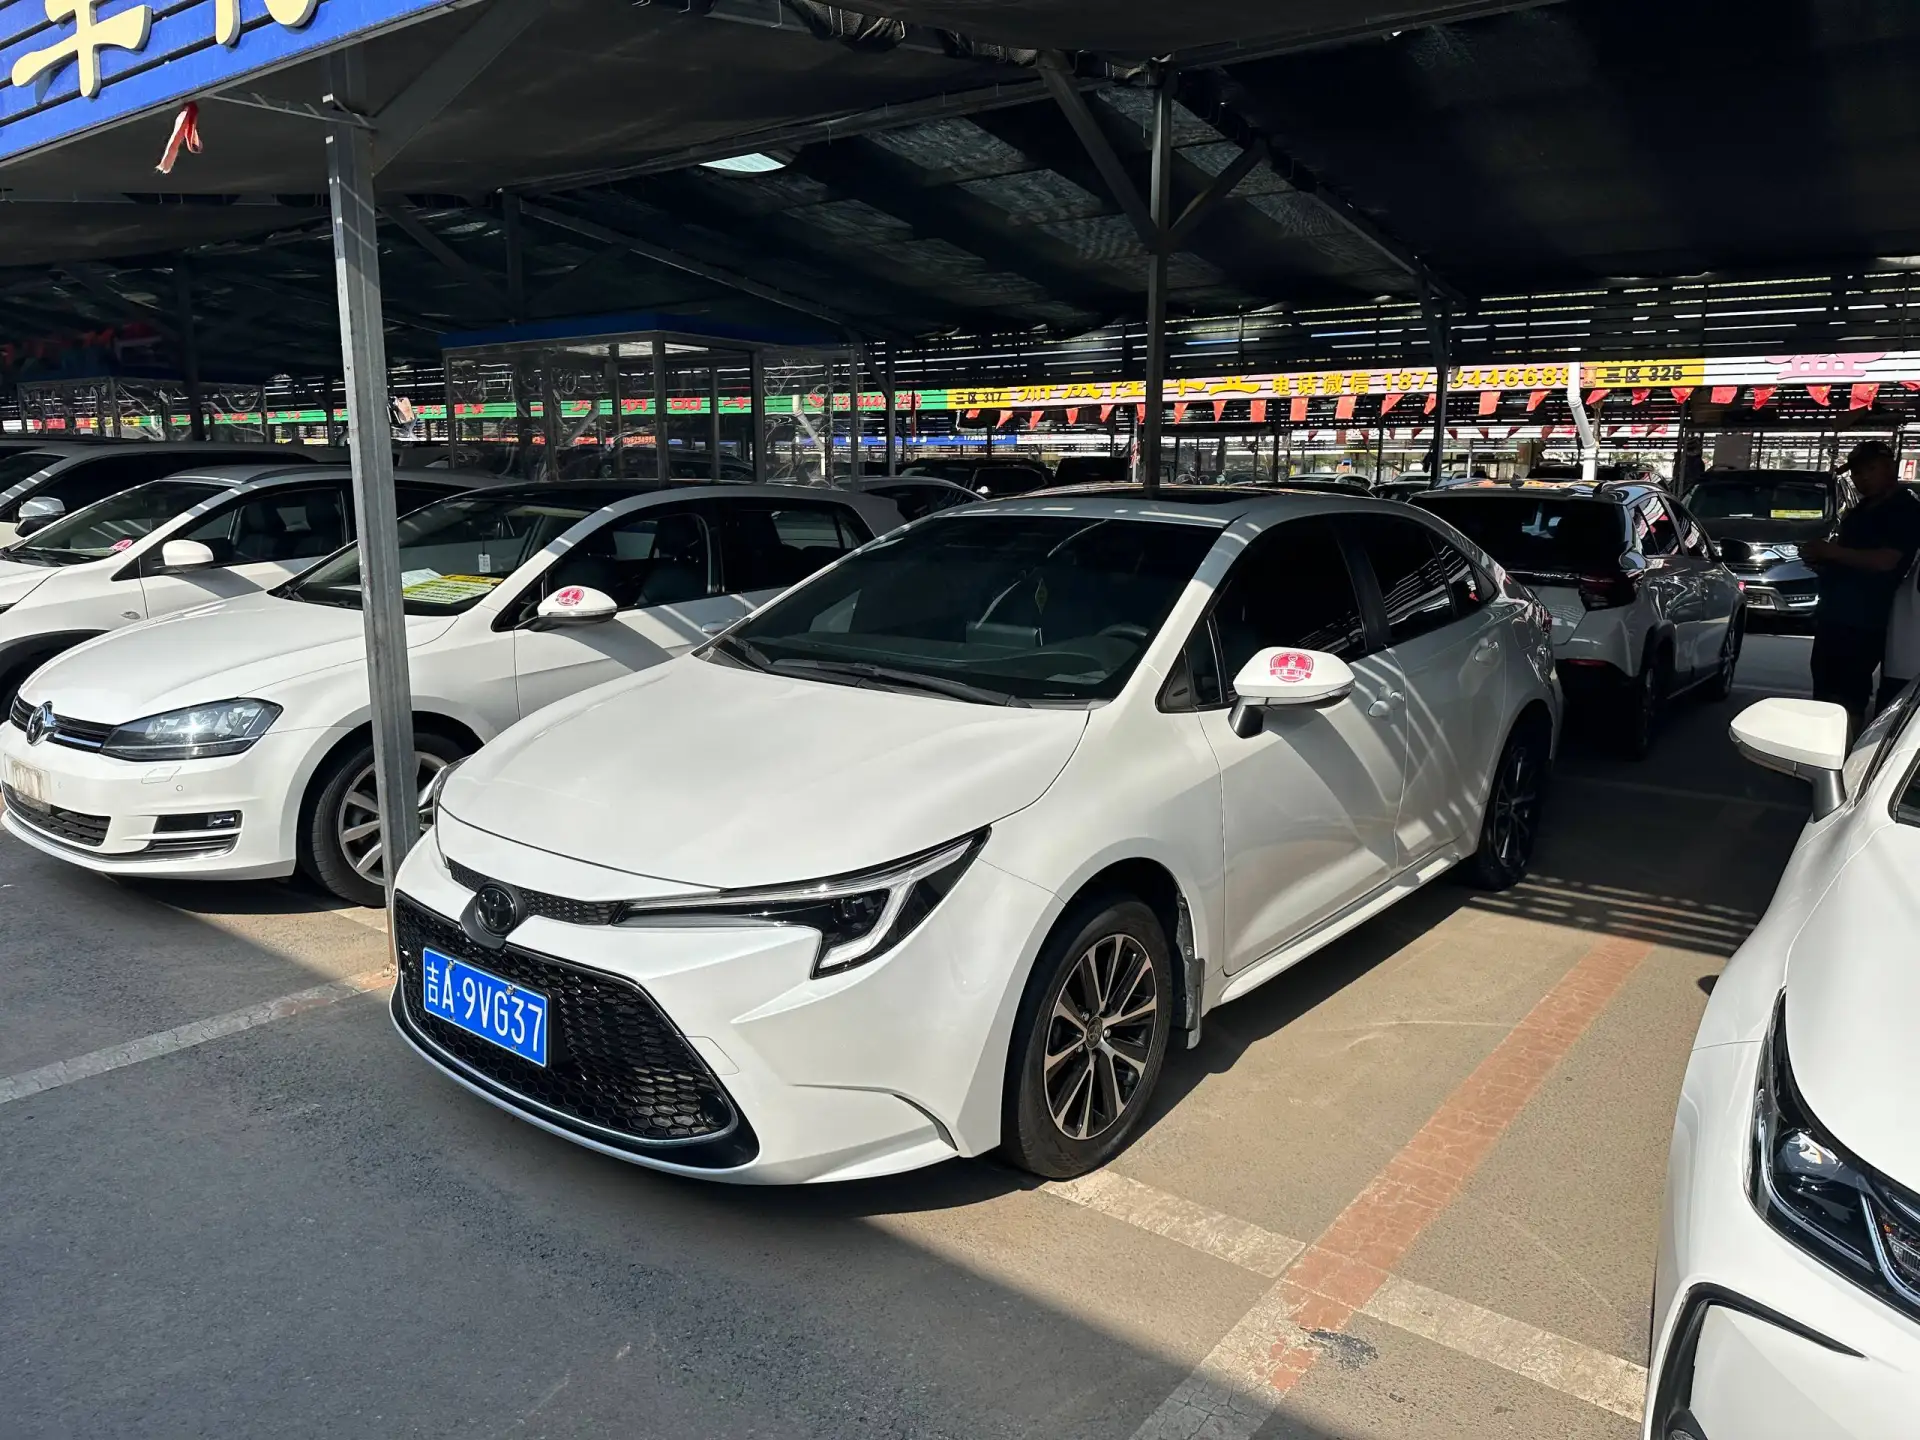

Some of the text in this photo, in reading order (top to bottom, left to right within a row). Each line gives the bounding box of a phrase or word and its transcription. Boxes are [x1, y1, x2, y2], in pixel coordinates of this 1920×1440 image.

[1272, 371, 1371, 396] 电话微信
[1604, 366, 1683, 384] 三区 325
[956, 391, 1002, 405] 三区 317
